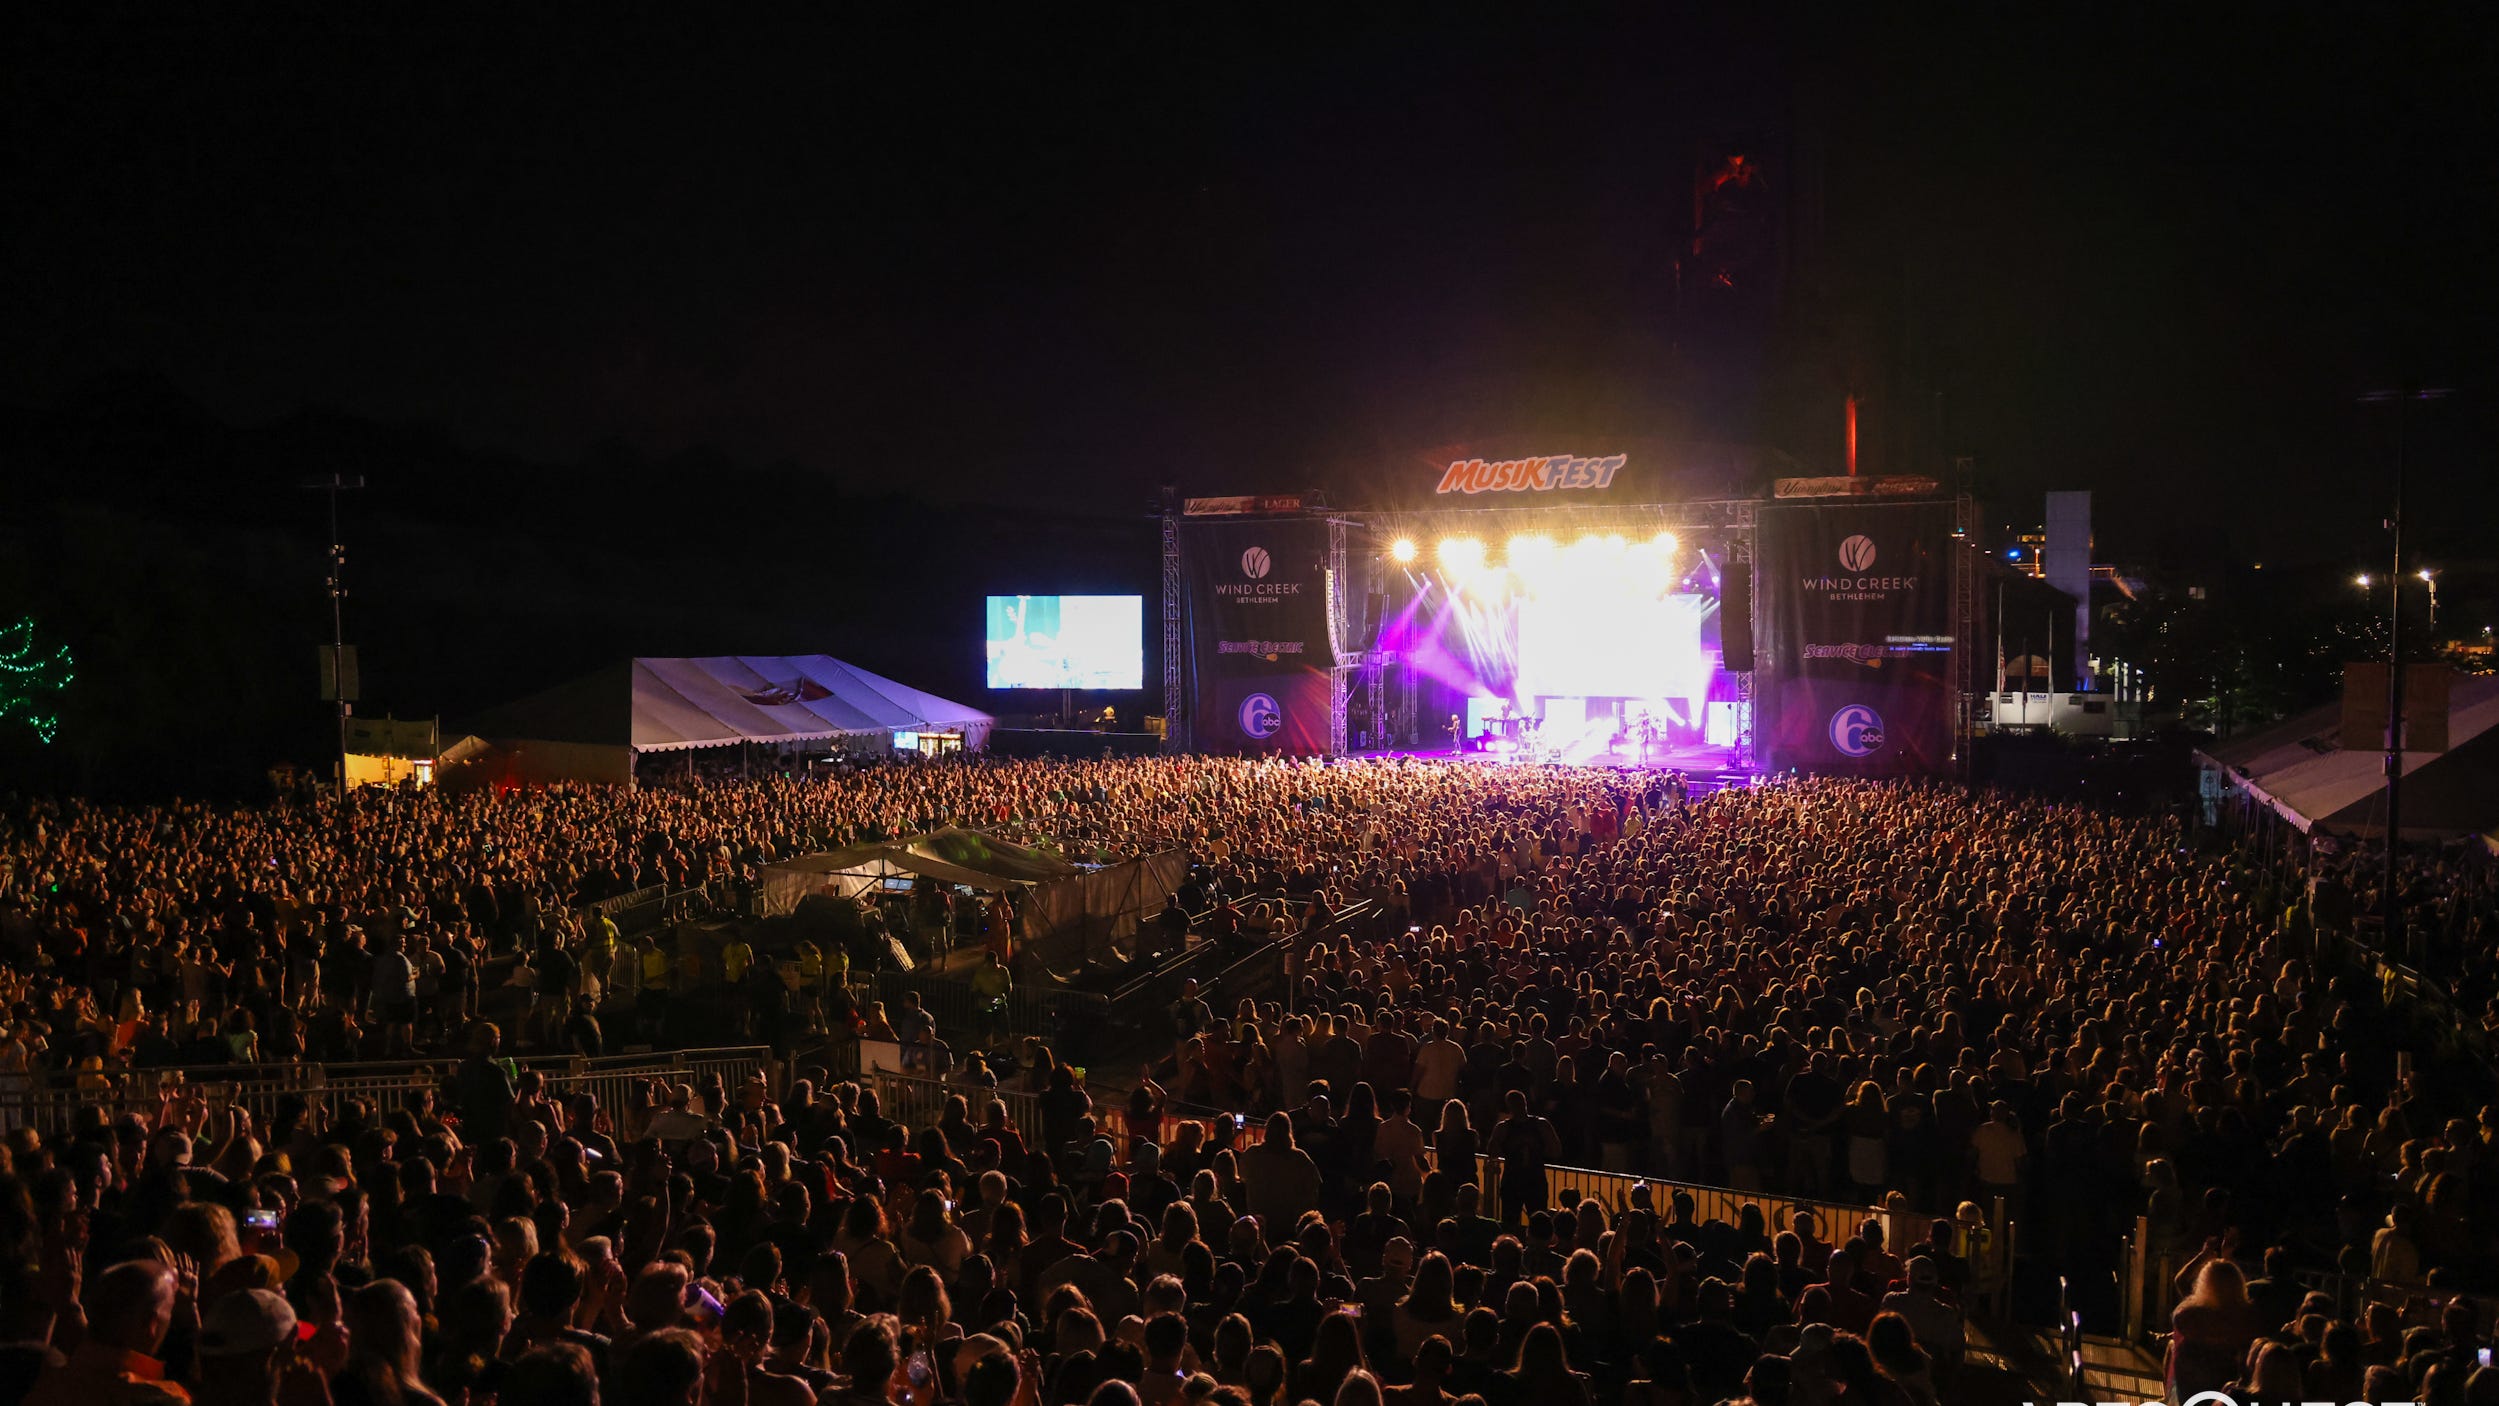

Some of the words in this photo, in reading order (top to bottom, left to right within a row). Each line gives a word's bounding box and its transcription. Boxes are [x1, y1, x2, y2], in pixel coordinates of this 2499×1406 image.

[1264, 499, 1300, 509] LAGER
[1215, 584, 1253, 595] WIND
[1256, 583, 1300, 594] CREEK
[1803, 578, 1851, 591] WIND
[1857, 577, 1914, 590] CREEK
[1236, 596, 1279, 604] BETHLEHEM
[1243, 696, 1272, 736] 6
[1262, 716, 1280, 726] abc
[1835, 708, 1873, 753] 6
[1861, 732, 1883, 742] abc
